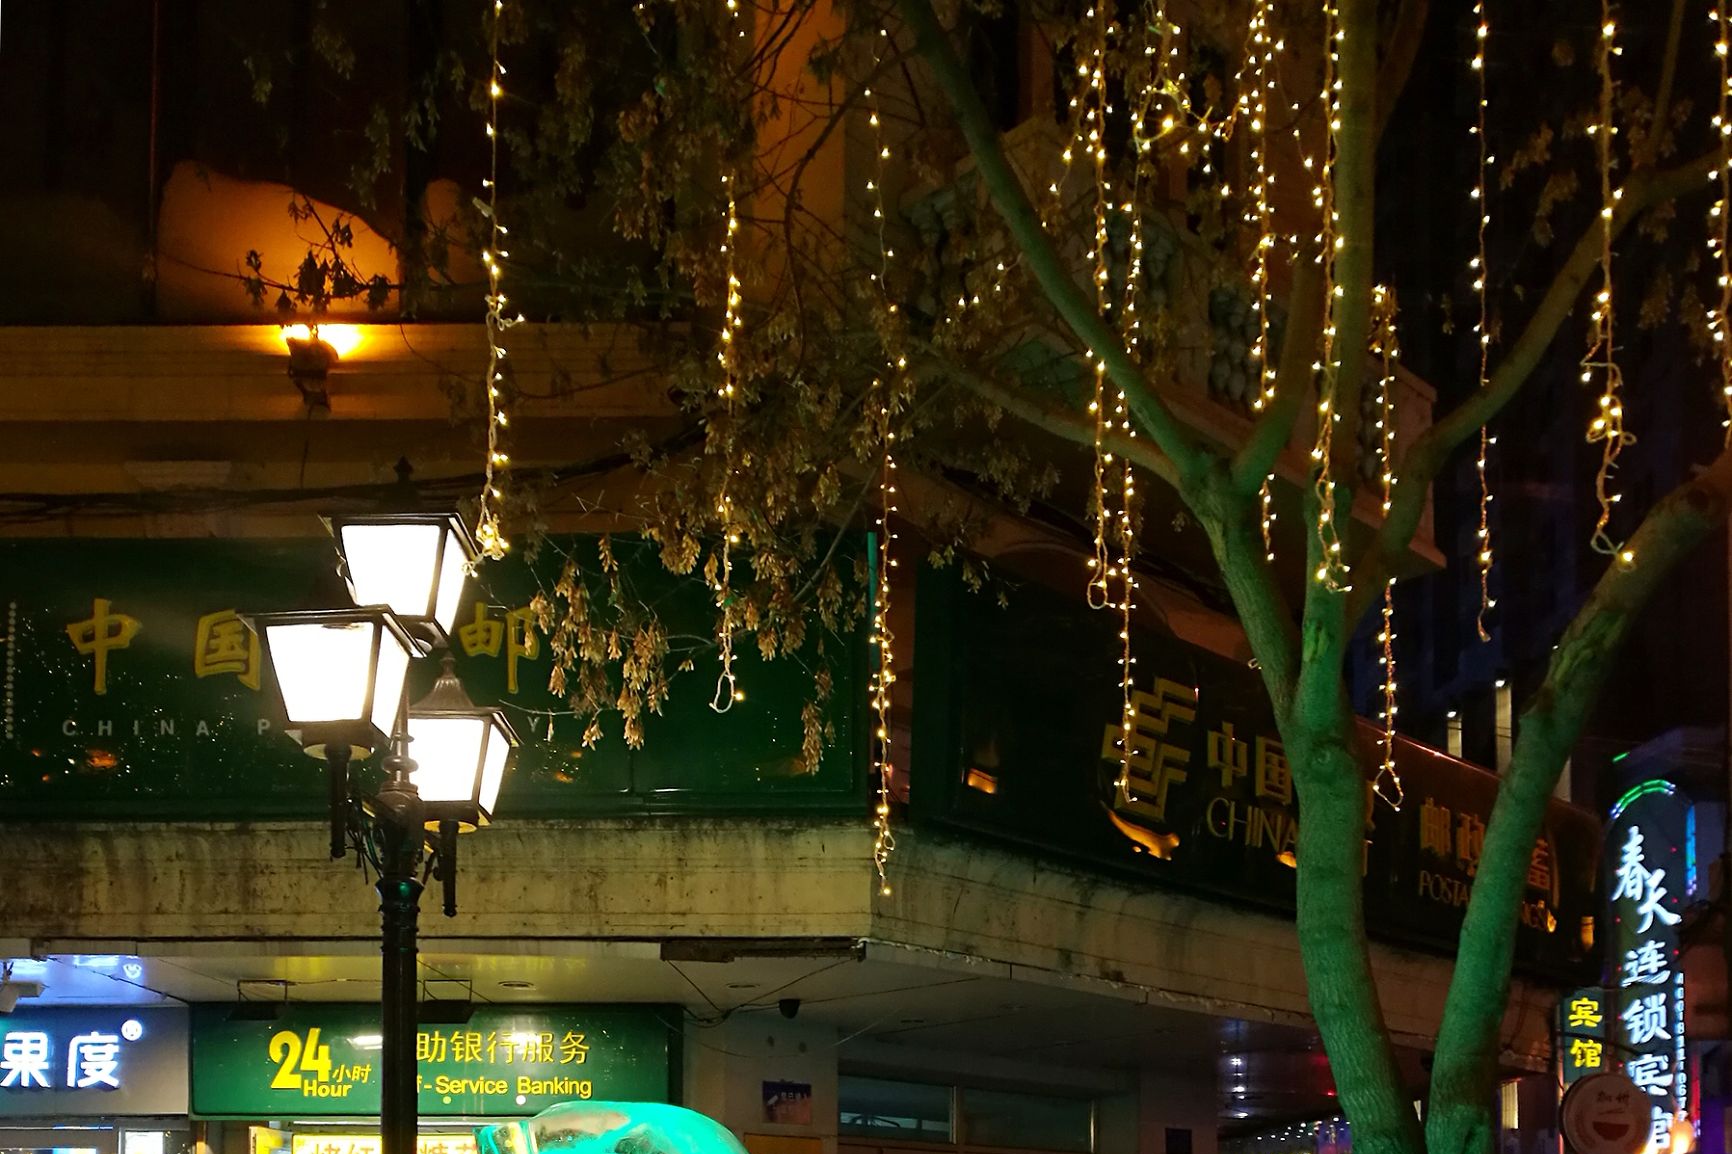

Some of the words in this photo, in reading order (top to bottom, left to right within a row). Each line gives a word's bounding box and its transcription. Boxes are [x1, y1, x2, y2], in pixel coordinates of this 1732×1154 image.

[66, 597, 540, 695] 中国邮
[63, 717, 210, 737] CHINA
[0, 1031, 120, 1088] 果度
[269, 1027, 332, 1089] 24
[332, 1063, 372, 1084] 小时
[416, 1031, 591, 1065] 助银行服务
[1568, 997, 1603, 1068] 宾馆
[303, 1079, 352, 1098] Hour
[517, 1076, 593, 1099] Banking
